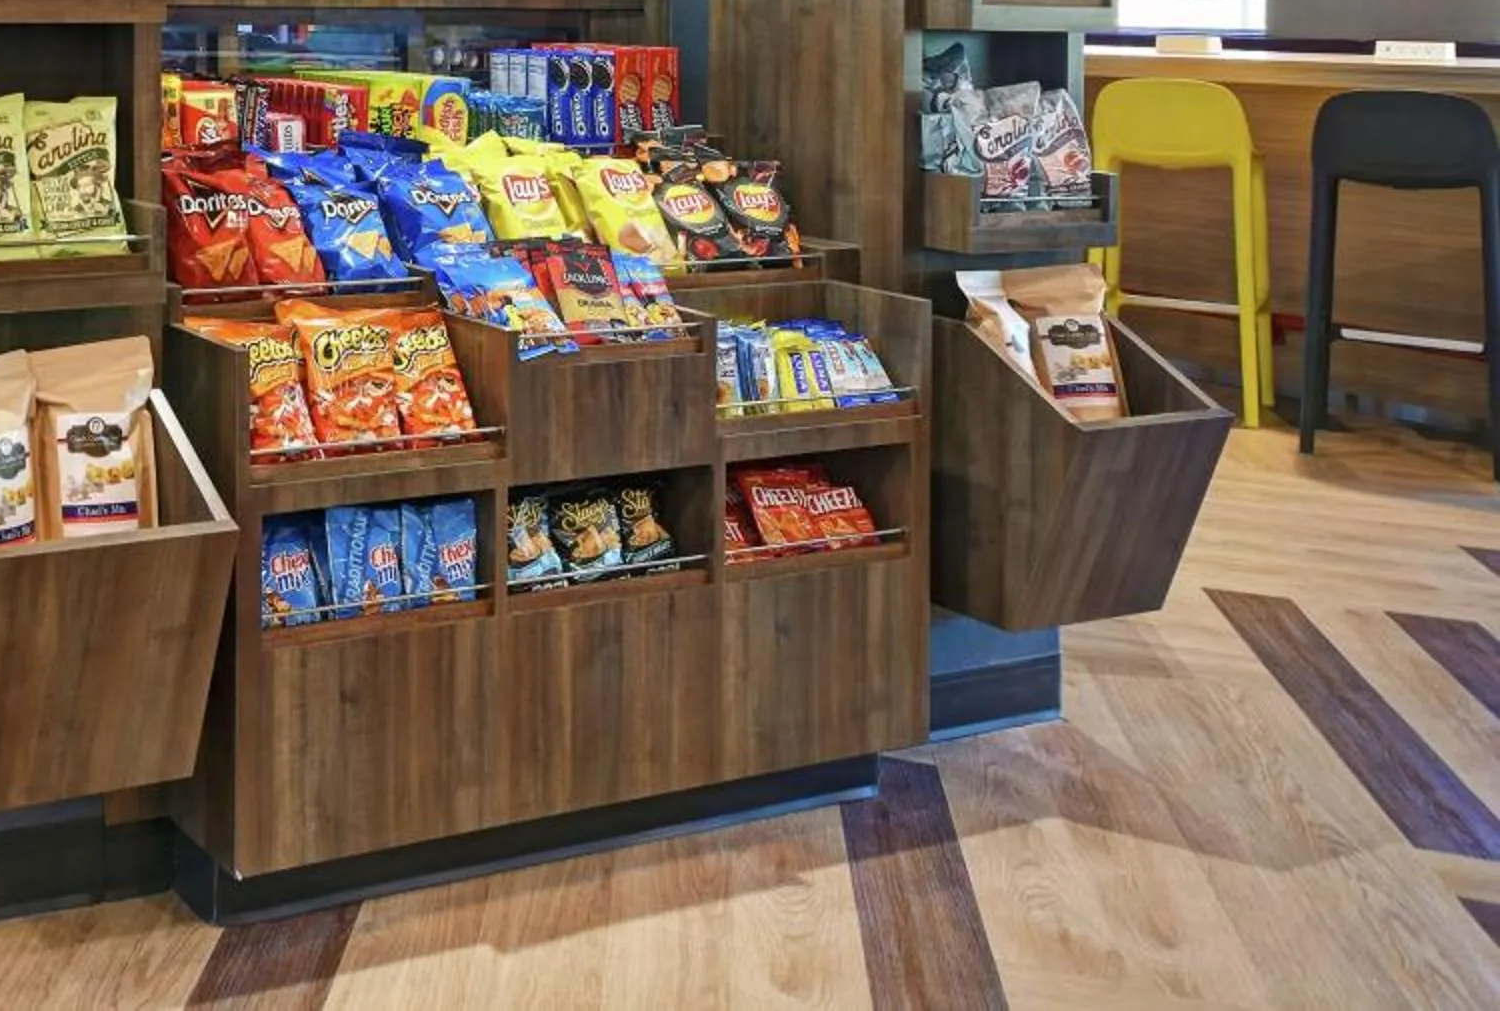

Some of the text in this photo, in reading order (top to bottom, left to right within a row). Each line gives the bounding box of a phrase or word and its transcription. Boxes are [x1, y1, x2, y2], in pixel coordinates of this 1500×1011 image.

[573, 91, 587, 137] OREO
[596, 92, 611, 137] OREO
[27, 124, 107, 181] Carolina
[503, 175, 550, 202] Lay's
[603, 168, 647, 193] Lay's
[180, 194, 248, 214] Doritos
[669, 192, 709, 215] Lay's
[314, 326, 389, 370] Cheetos
[793, 353, 809, 395] LUNA
[812, 352, 830, 393] LUNA
[269, 548, 310, 576] Chex
